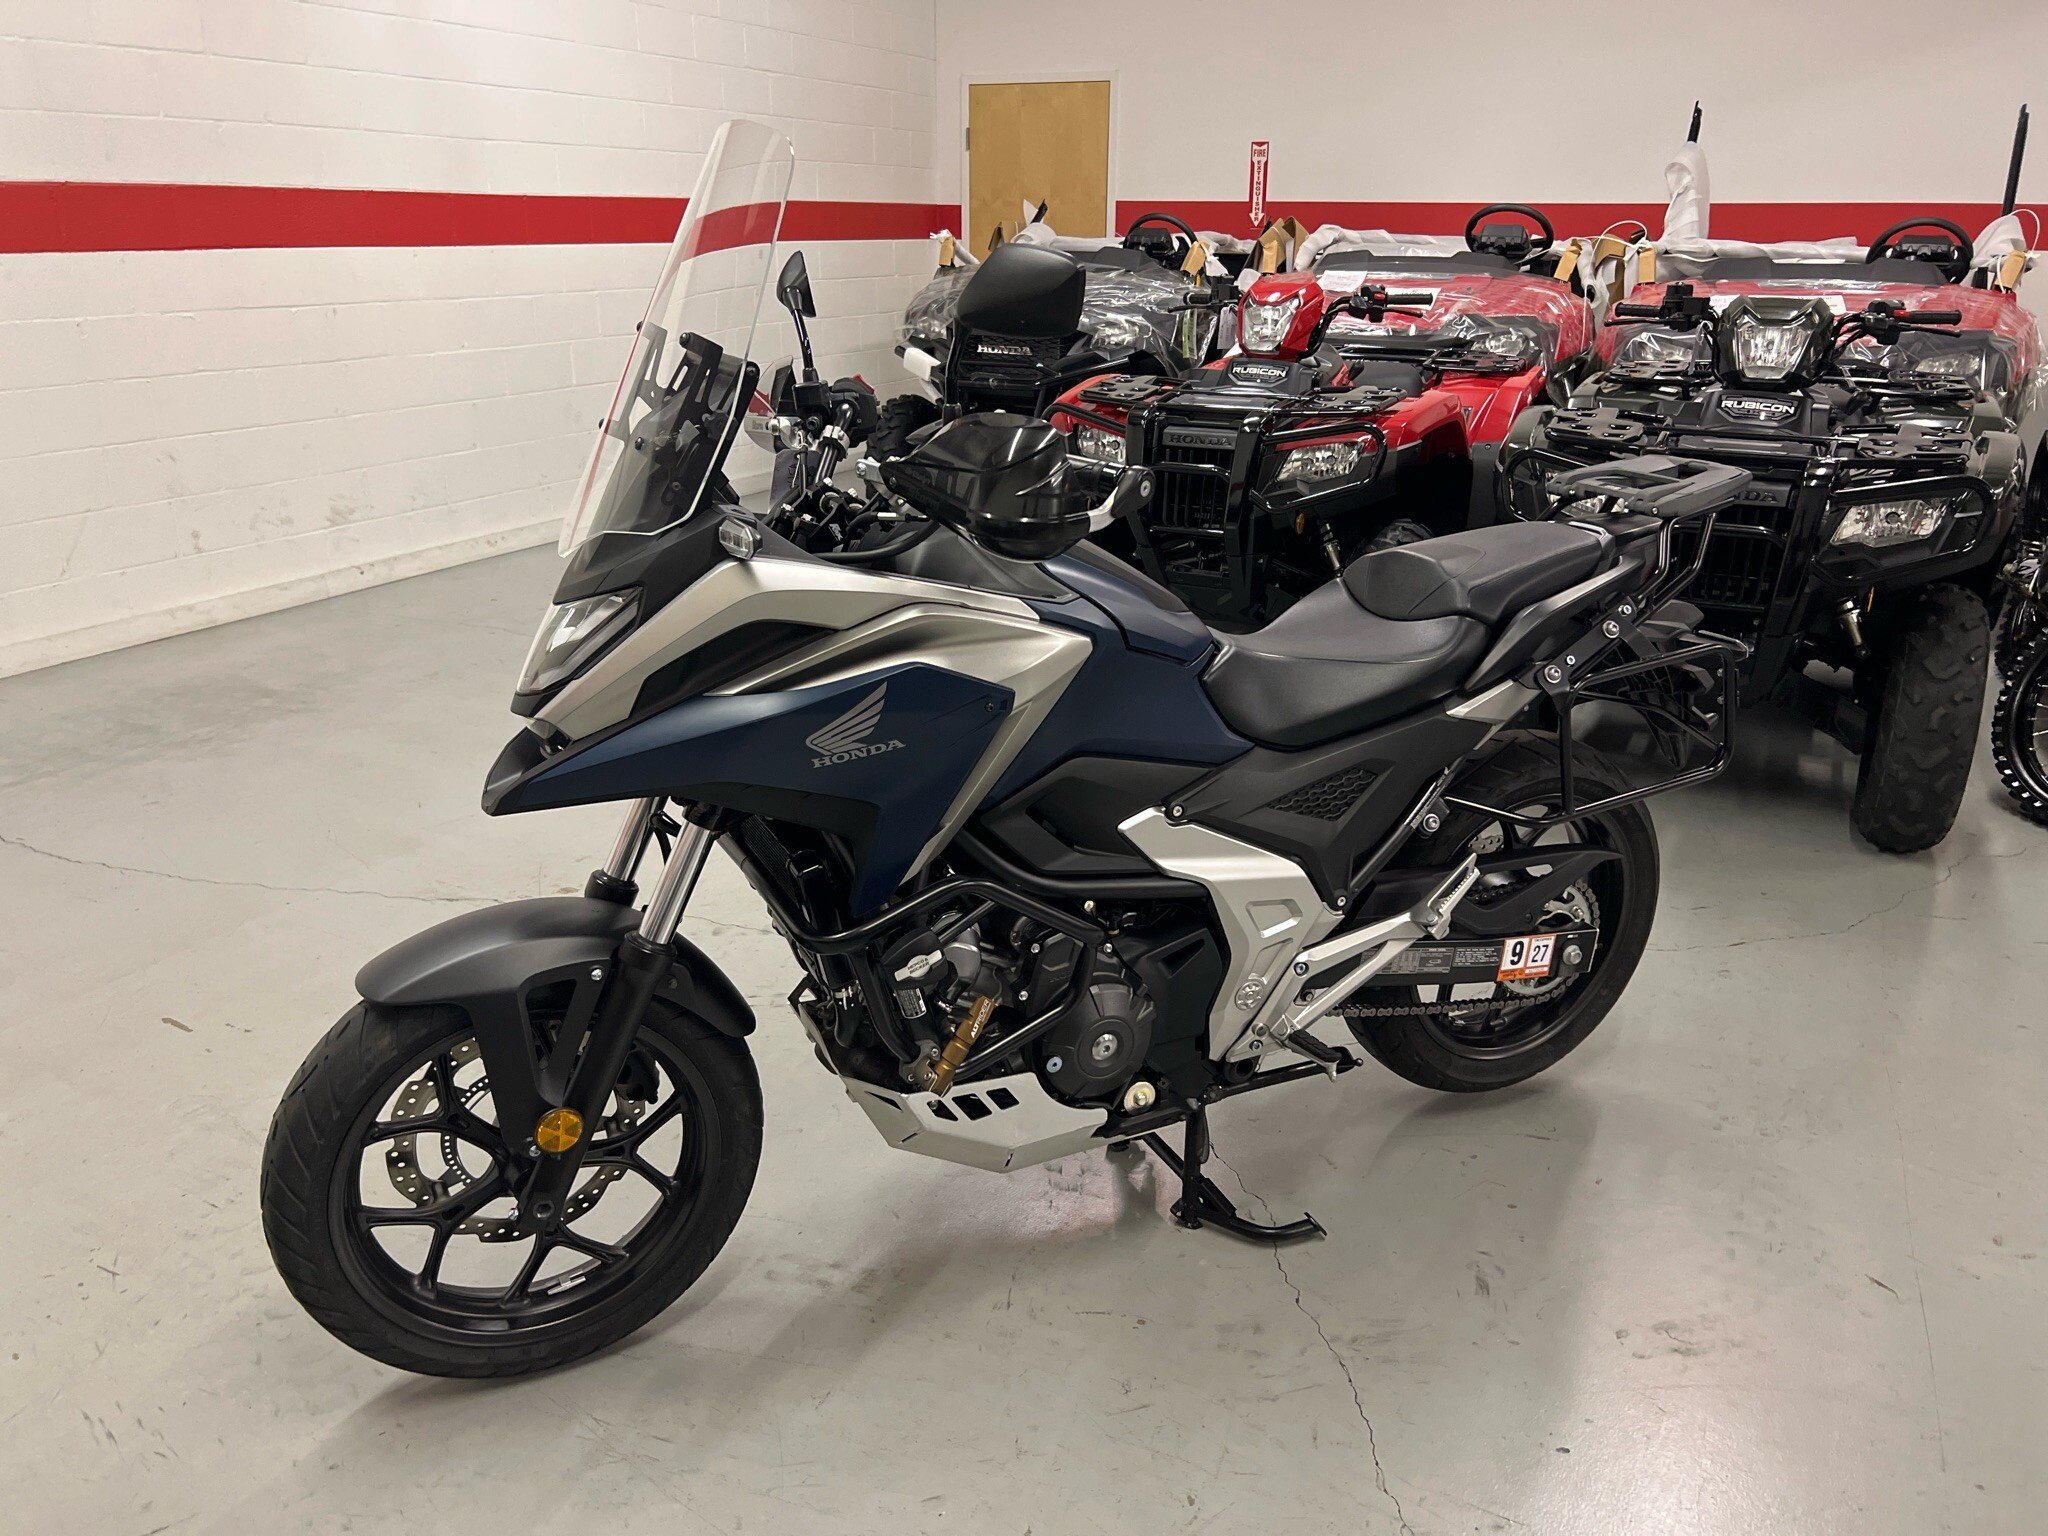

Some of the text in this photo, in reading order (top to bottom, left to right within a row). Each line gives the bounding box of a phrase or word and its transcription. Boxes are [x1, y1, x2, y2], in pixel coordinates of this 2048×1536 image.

[1253, 149, 1266, 157] FIRE
[1254, 161, 1262, 221] EXTINGUISHER
[977, 345, 1032, 355] HONDA
[1232, 366, 1287, 377] RUBICON
[1721, 400, 1795, 414] RUBICON
[1168, 434, 1232, 445] HONDA
[810, 740, 907, 768] HONDA
[1509, 940, 1525, 966] 9
[1531, 944, 1549, 963] 27
